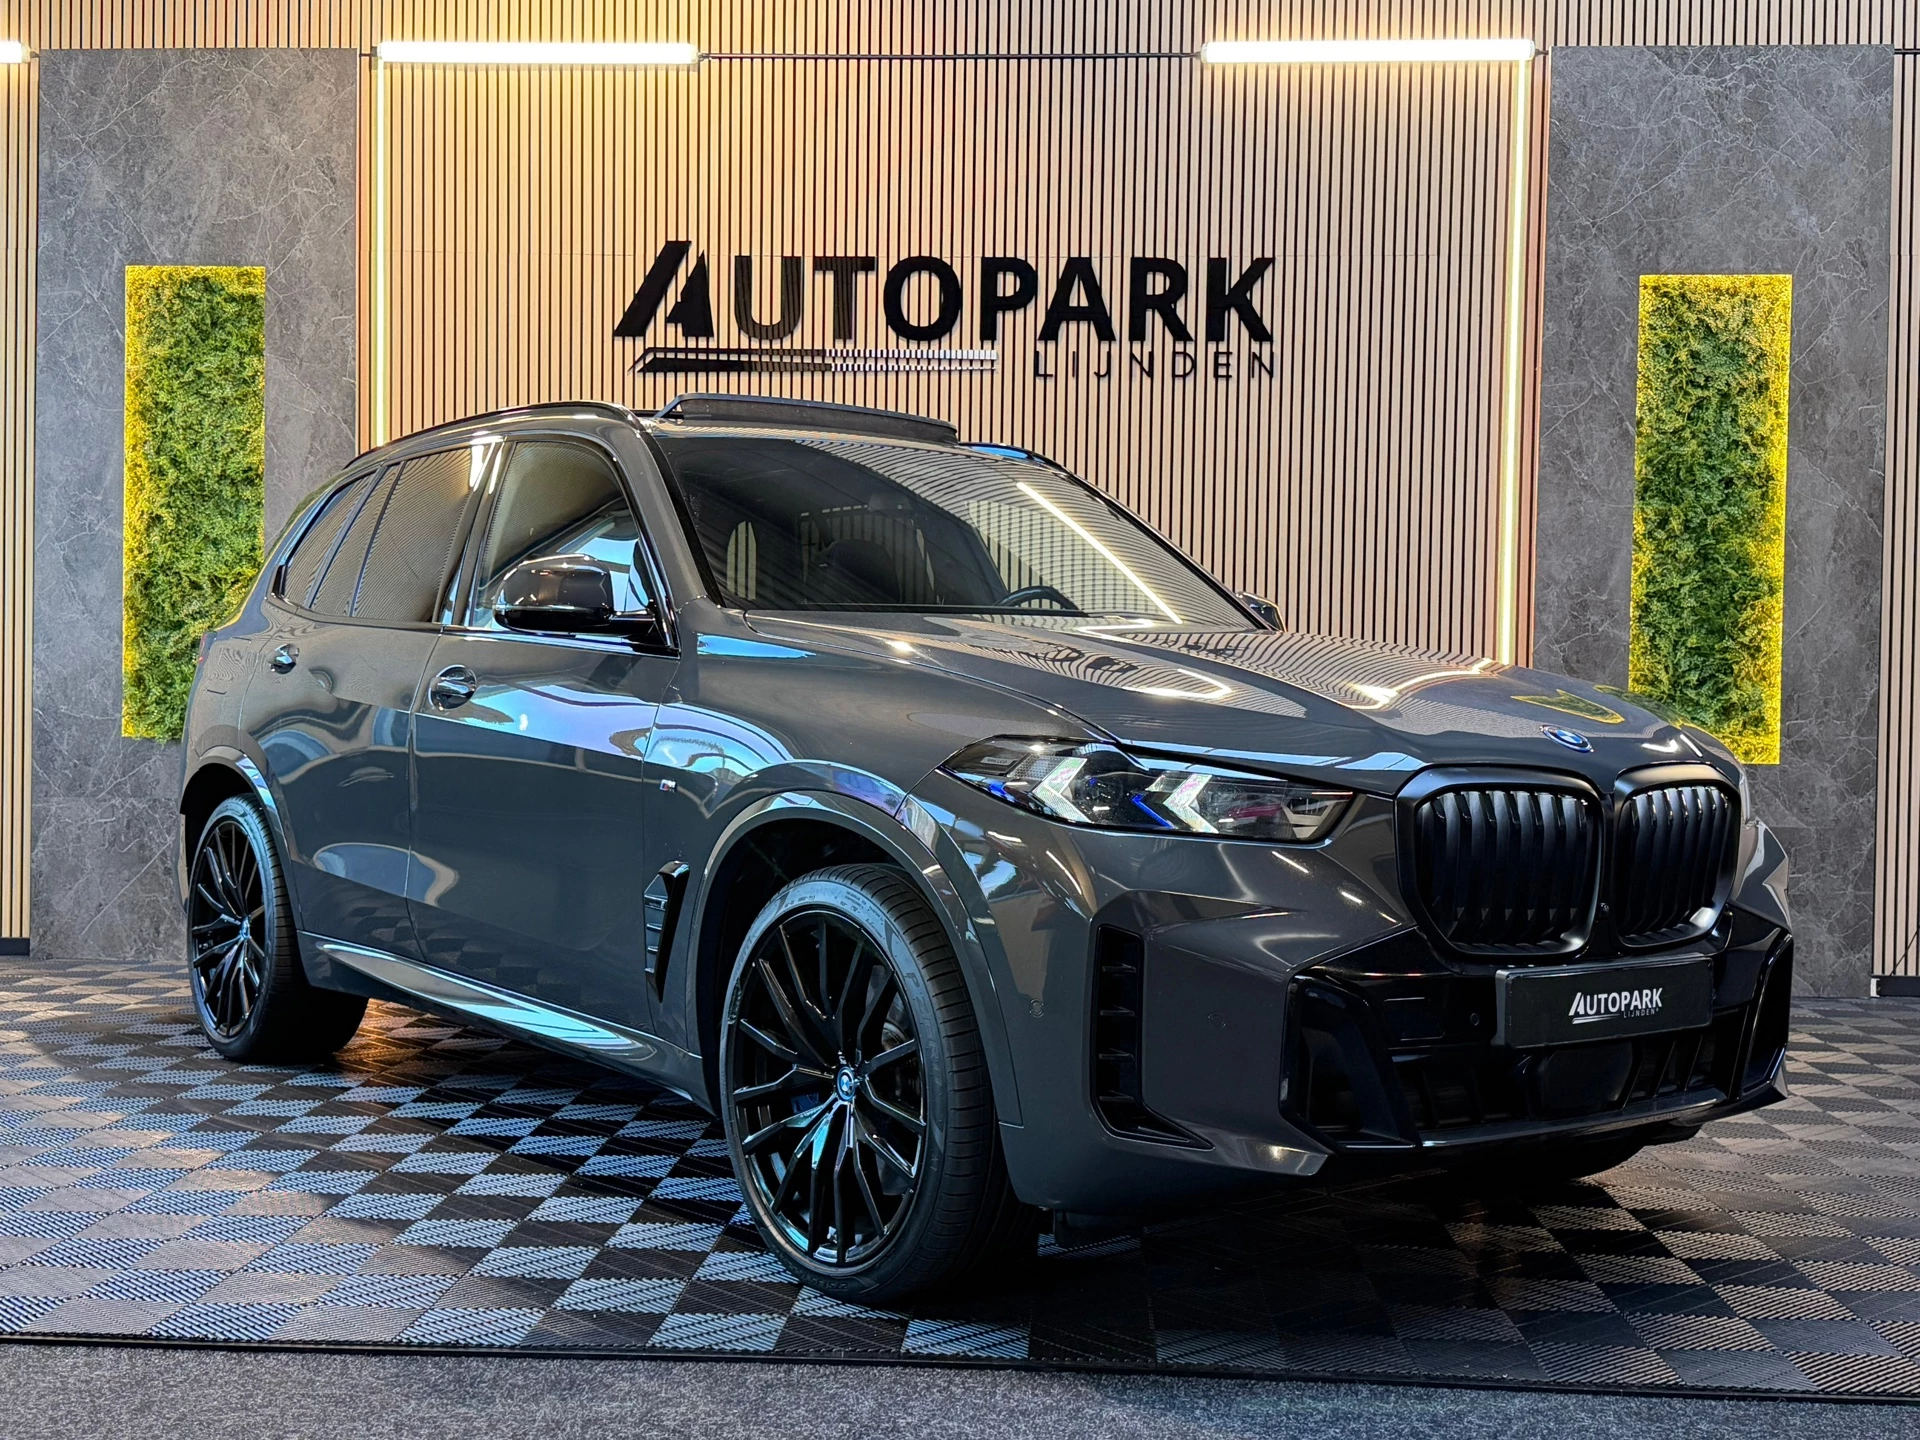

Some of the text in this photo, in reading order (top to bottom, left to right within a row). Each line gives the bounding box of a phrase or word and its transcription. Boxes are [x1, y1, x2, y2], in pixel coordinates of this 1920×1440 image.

[613, 241, 1275, 341] AUTOPARK
[1034, 350, 1274, 378] LIJNDEN
[1568, 987, 1663, 1016] AUTOPARK
